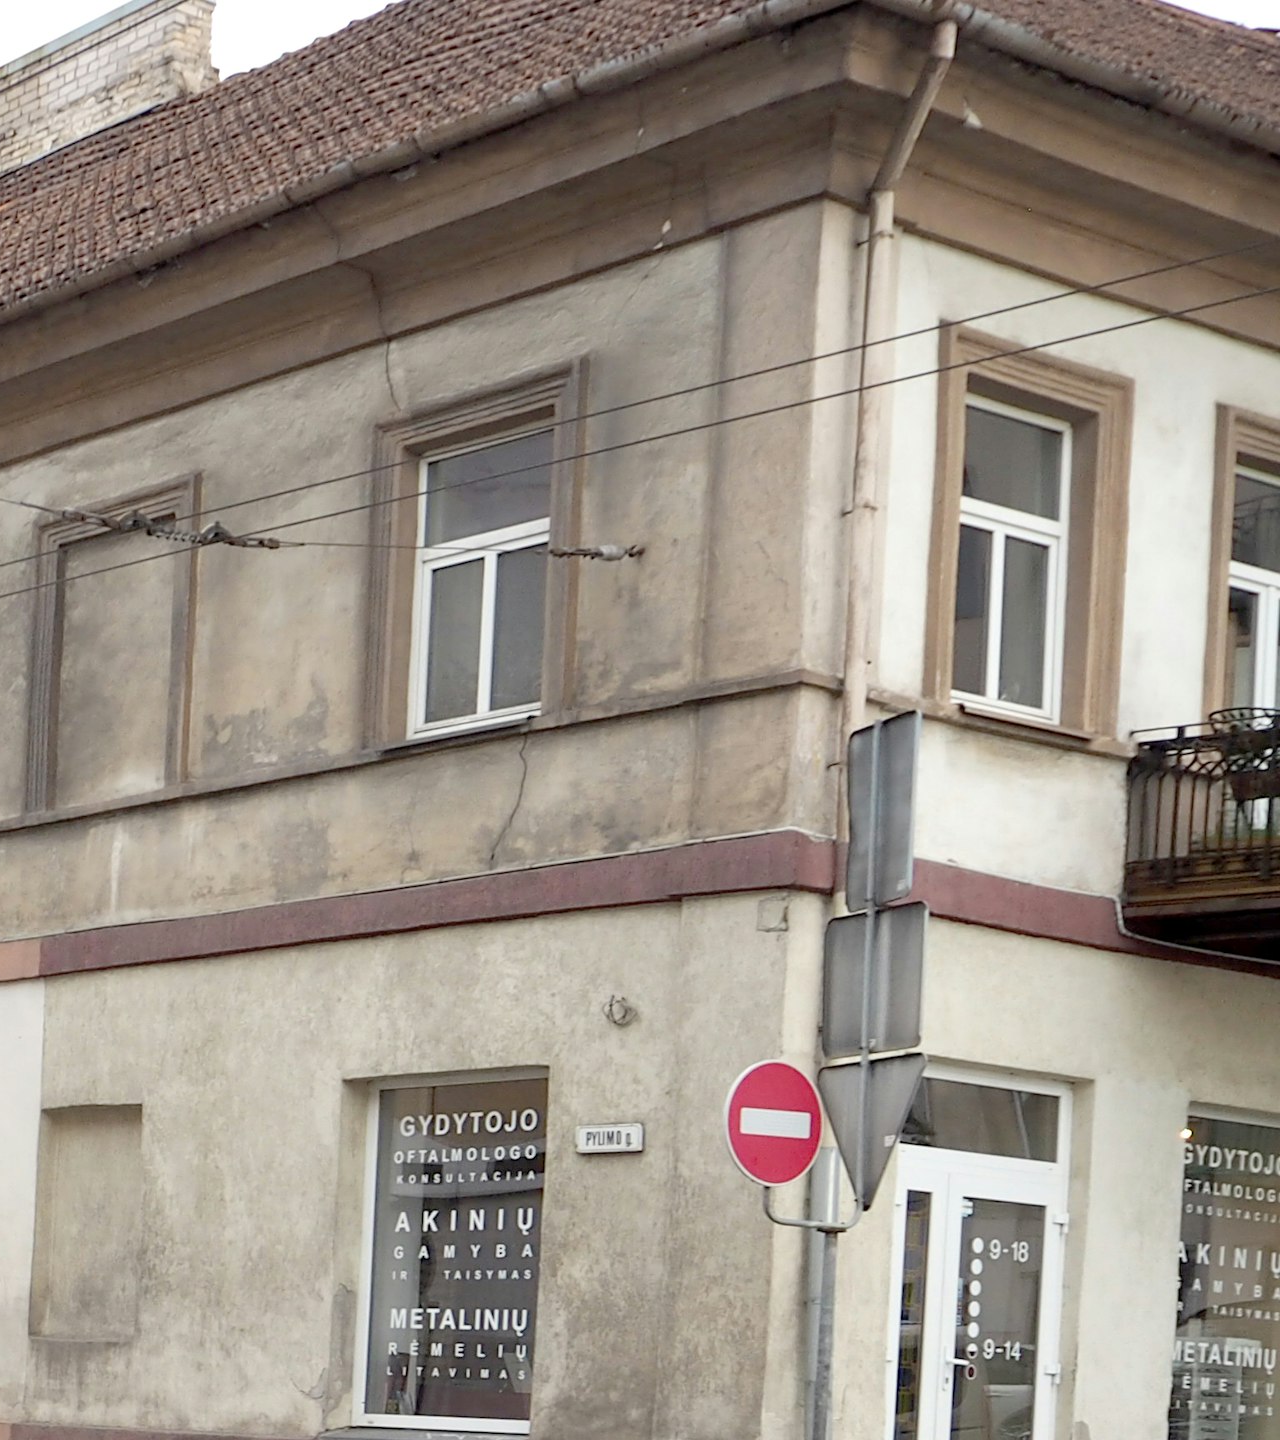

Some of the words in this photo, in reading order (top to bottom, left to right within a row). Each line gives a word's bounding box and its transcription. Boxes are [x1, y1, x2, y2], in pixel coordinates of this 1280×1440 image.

[399, 1109, 538, 1137] GYDYTOJO
[585, 1130, 622, 1146] PYLIMO
[393, 1145, 537, 1164] OFTALMOLOGO
[396, 1170, 536, 1185] KONSULTACIJA
[1183, 1179, 1280, 1203] FTALMOLOG
[394, 1207, 534, 1236] AKINIŲ
[1184, 1203, 1280, 1223] ONSULTACIJ
[393, 1244, 534, 1259] GAMYBA
[989, 1239, 1029, 1263] 9-18
[392, 1271, 408, 1281] IR
[443, 1269, 532, 1281] TAISYMAS
[390, 1308, 528, 1337] METALINIŲ
[1213, 1304, 1280, 1321] TAISYMAS
[388, 1339, 527, 1362] RĖMELIŲ
[982, 1338, 1021, 1362] 9-14
[386, 1366, 526, 1380] LITAVIMAS
[1181, 1373, 1275, 1399] ĖMELIŲ
[1174, 1400, 1274, 1417] ITAVIMAS
